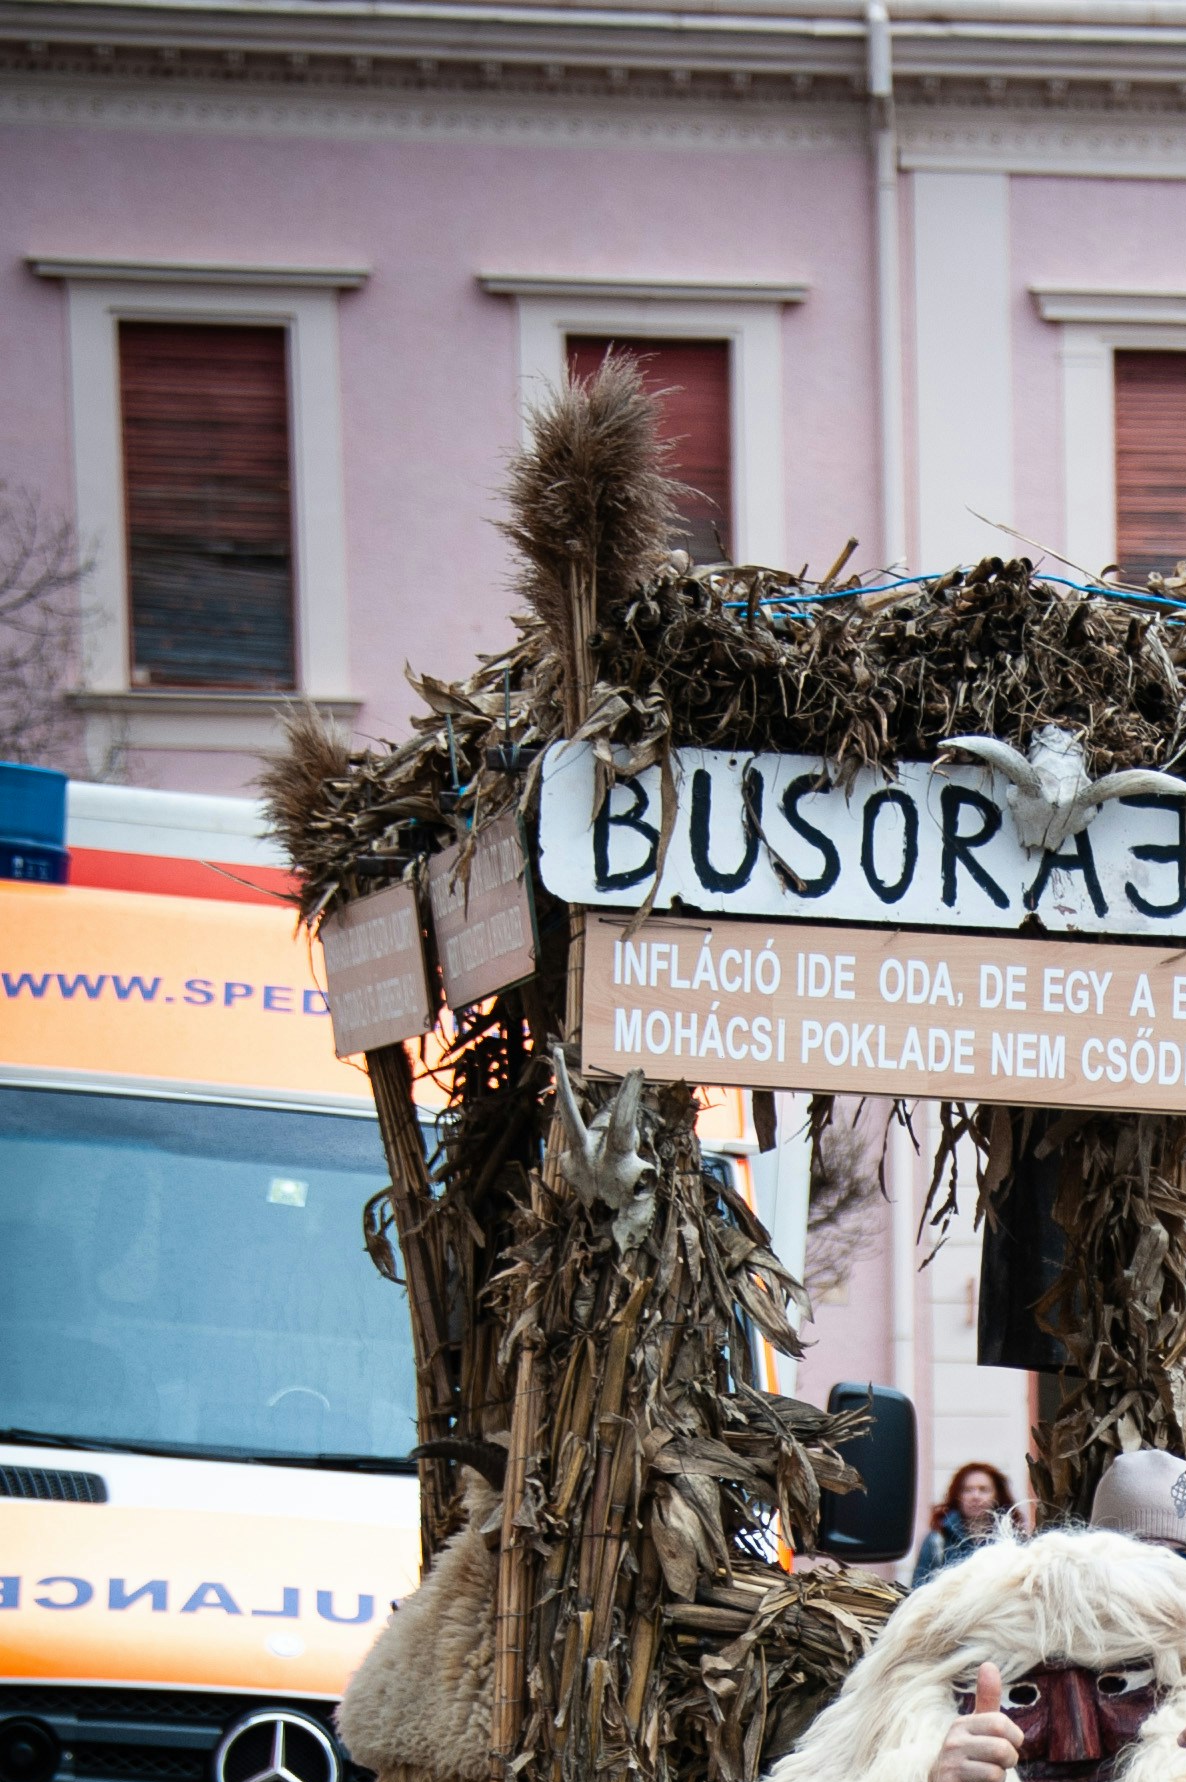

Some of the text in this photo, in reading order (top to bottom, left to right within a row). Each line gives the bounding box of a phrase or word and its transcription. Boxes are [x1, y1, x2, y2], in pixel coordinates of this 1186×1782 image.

[613, 934, 781, 994] INFLÁCIÓ
[797, 952, 857, 999] IDE
[879, 958, 963, 1008] ODA,
[979, 964, 1027, 1012] DE
[1043, 968, 1113, 1015] EGY
[1129, 973, 1156, 1019] A
[614, 1001, 786, 1063] MOHÁCSI
[801, 1020, 976, 1075] POKLADE
[991, 1032, 1066, 1080] NEM
